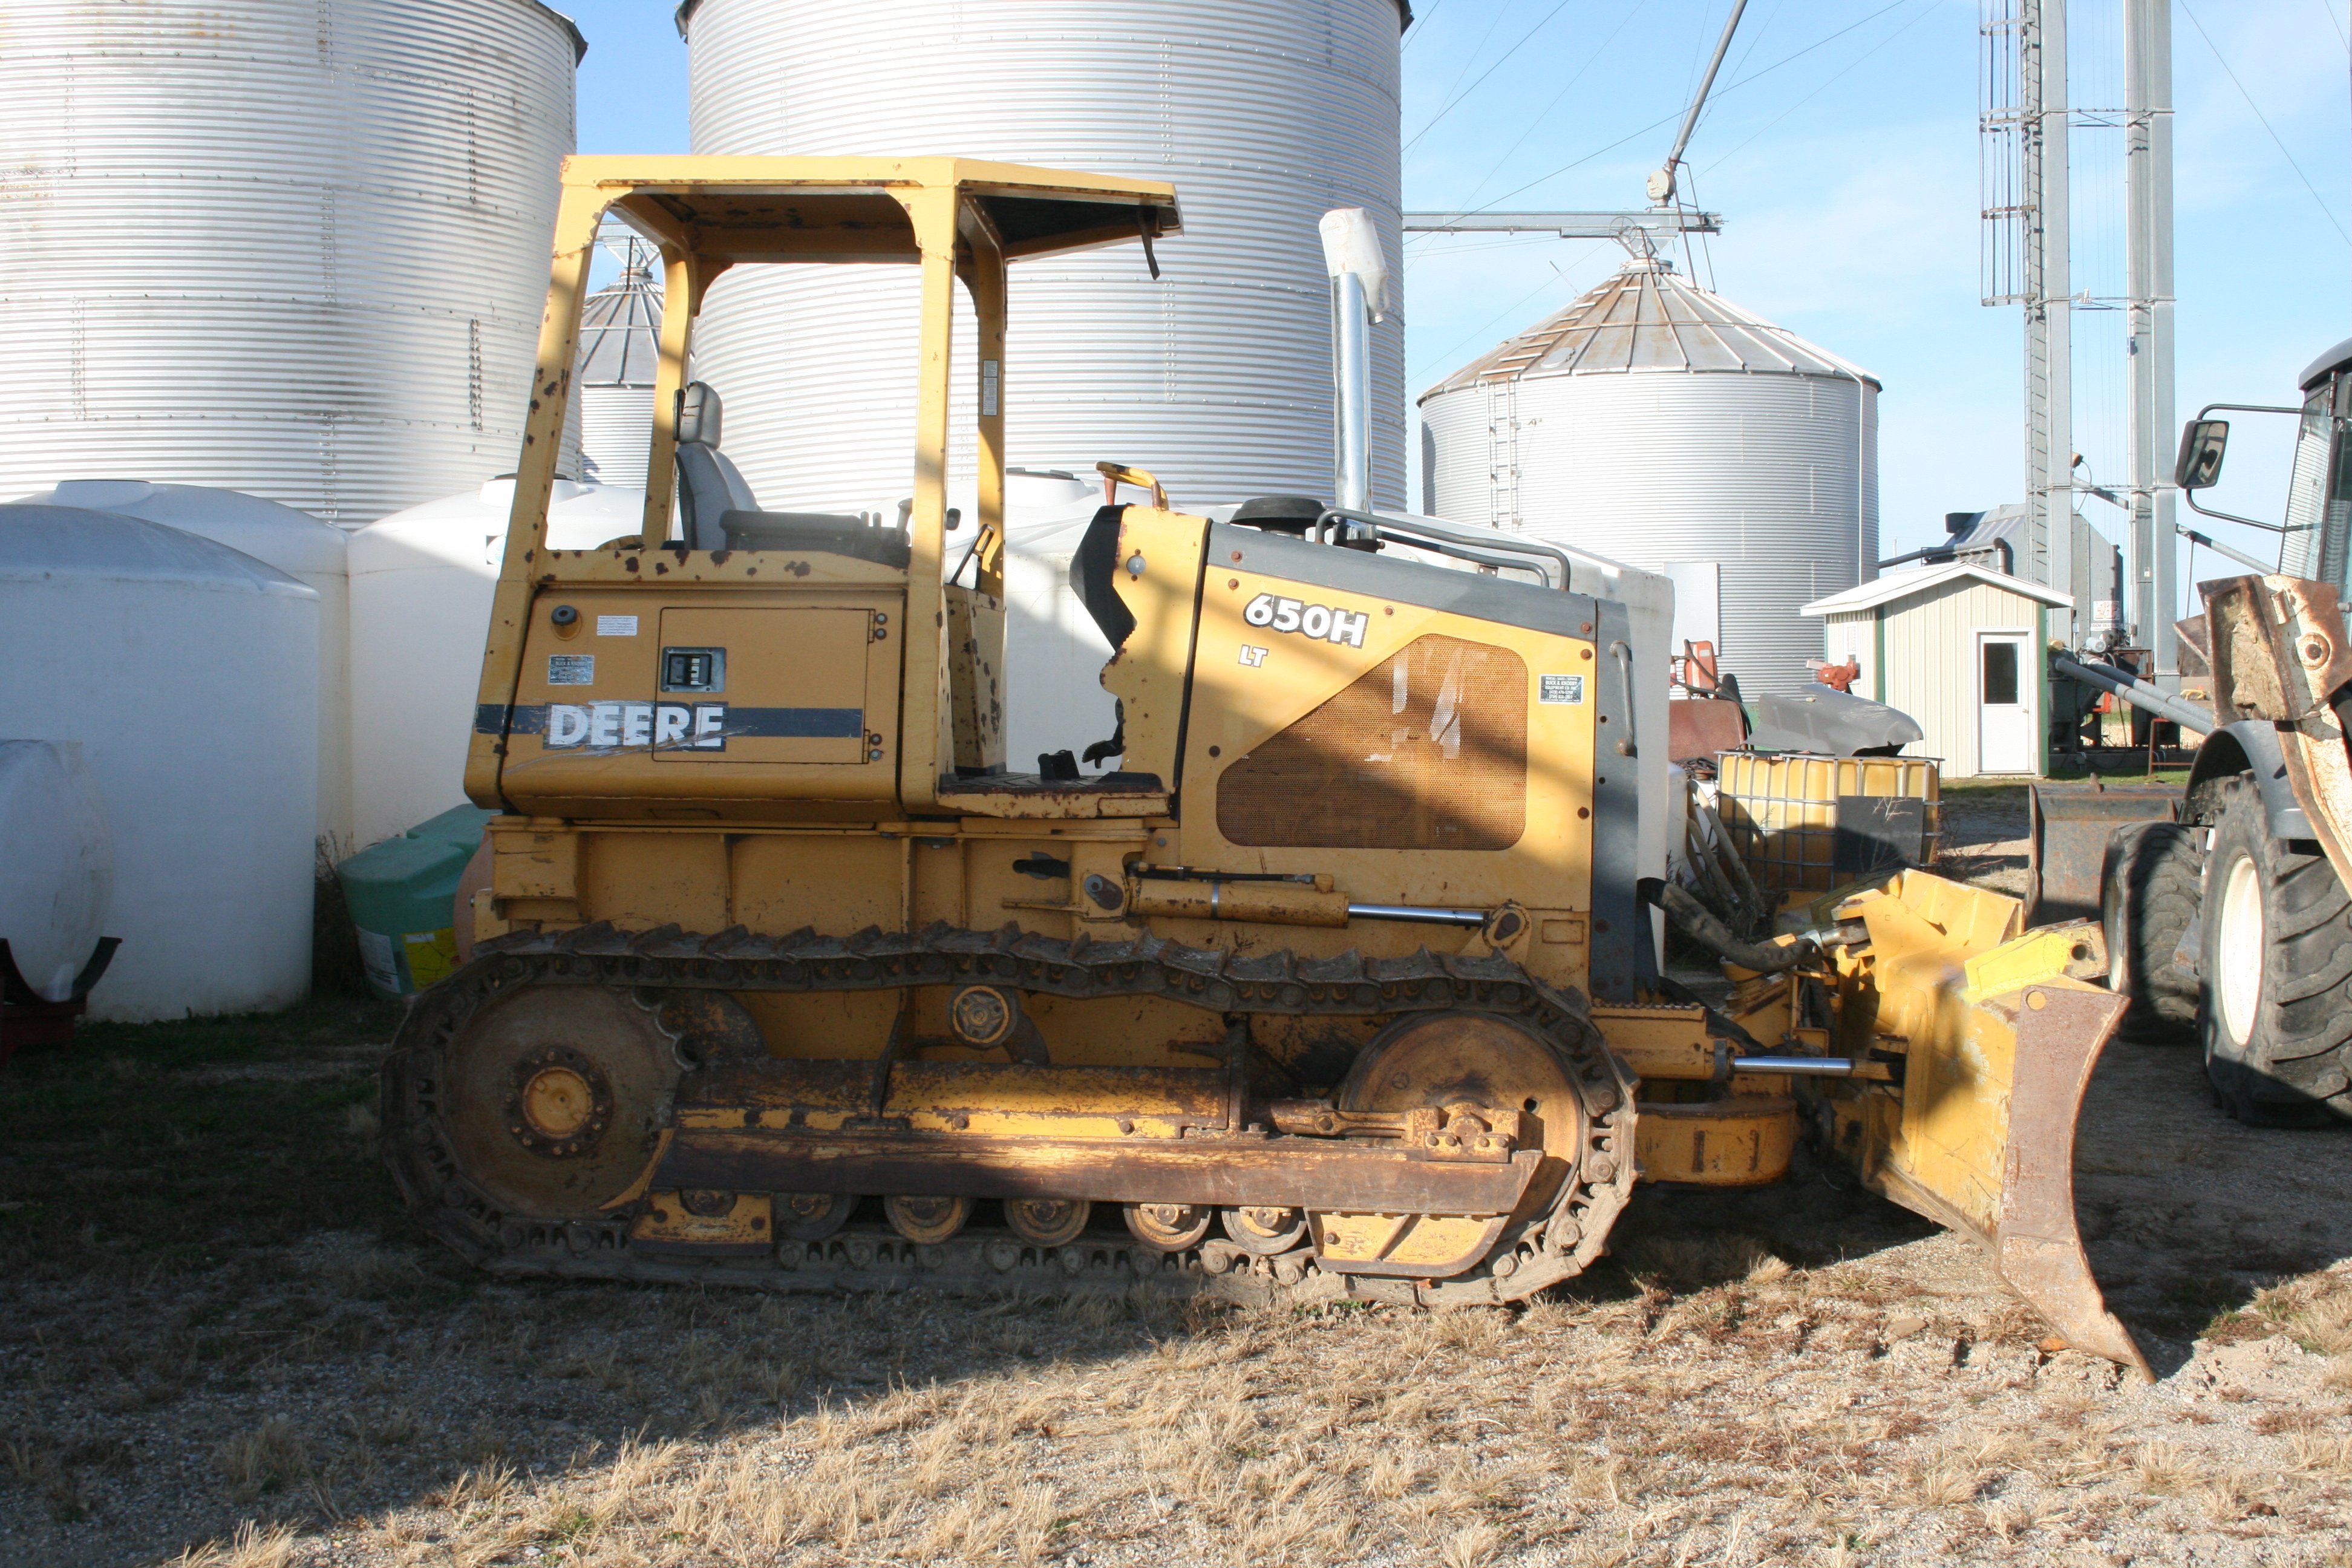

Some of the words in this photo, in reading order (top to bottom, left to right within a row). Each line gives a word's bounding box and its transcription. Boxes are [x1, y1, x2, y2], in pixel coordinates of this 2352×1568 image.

[1244, 592, 1369, 648] 650H
[1238, 644, 1269, 668] LT
[548, 704, 724, 747] DEERE
